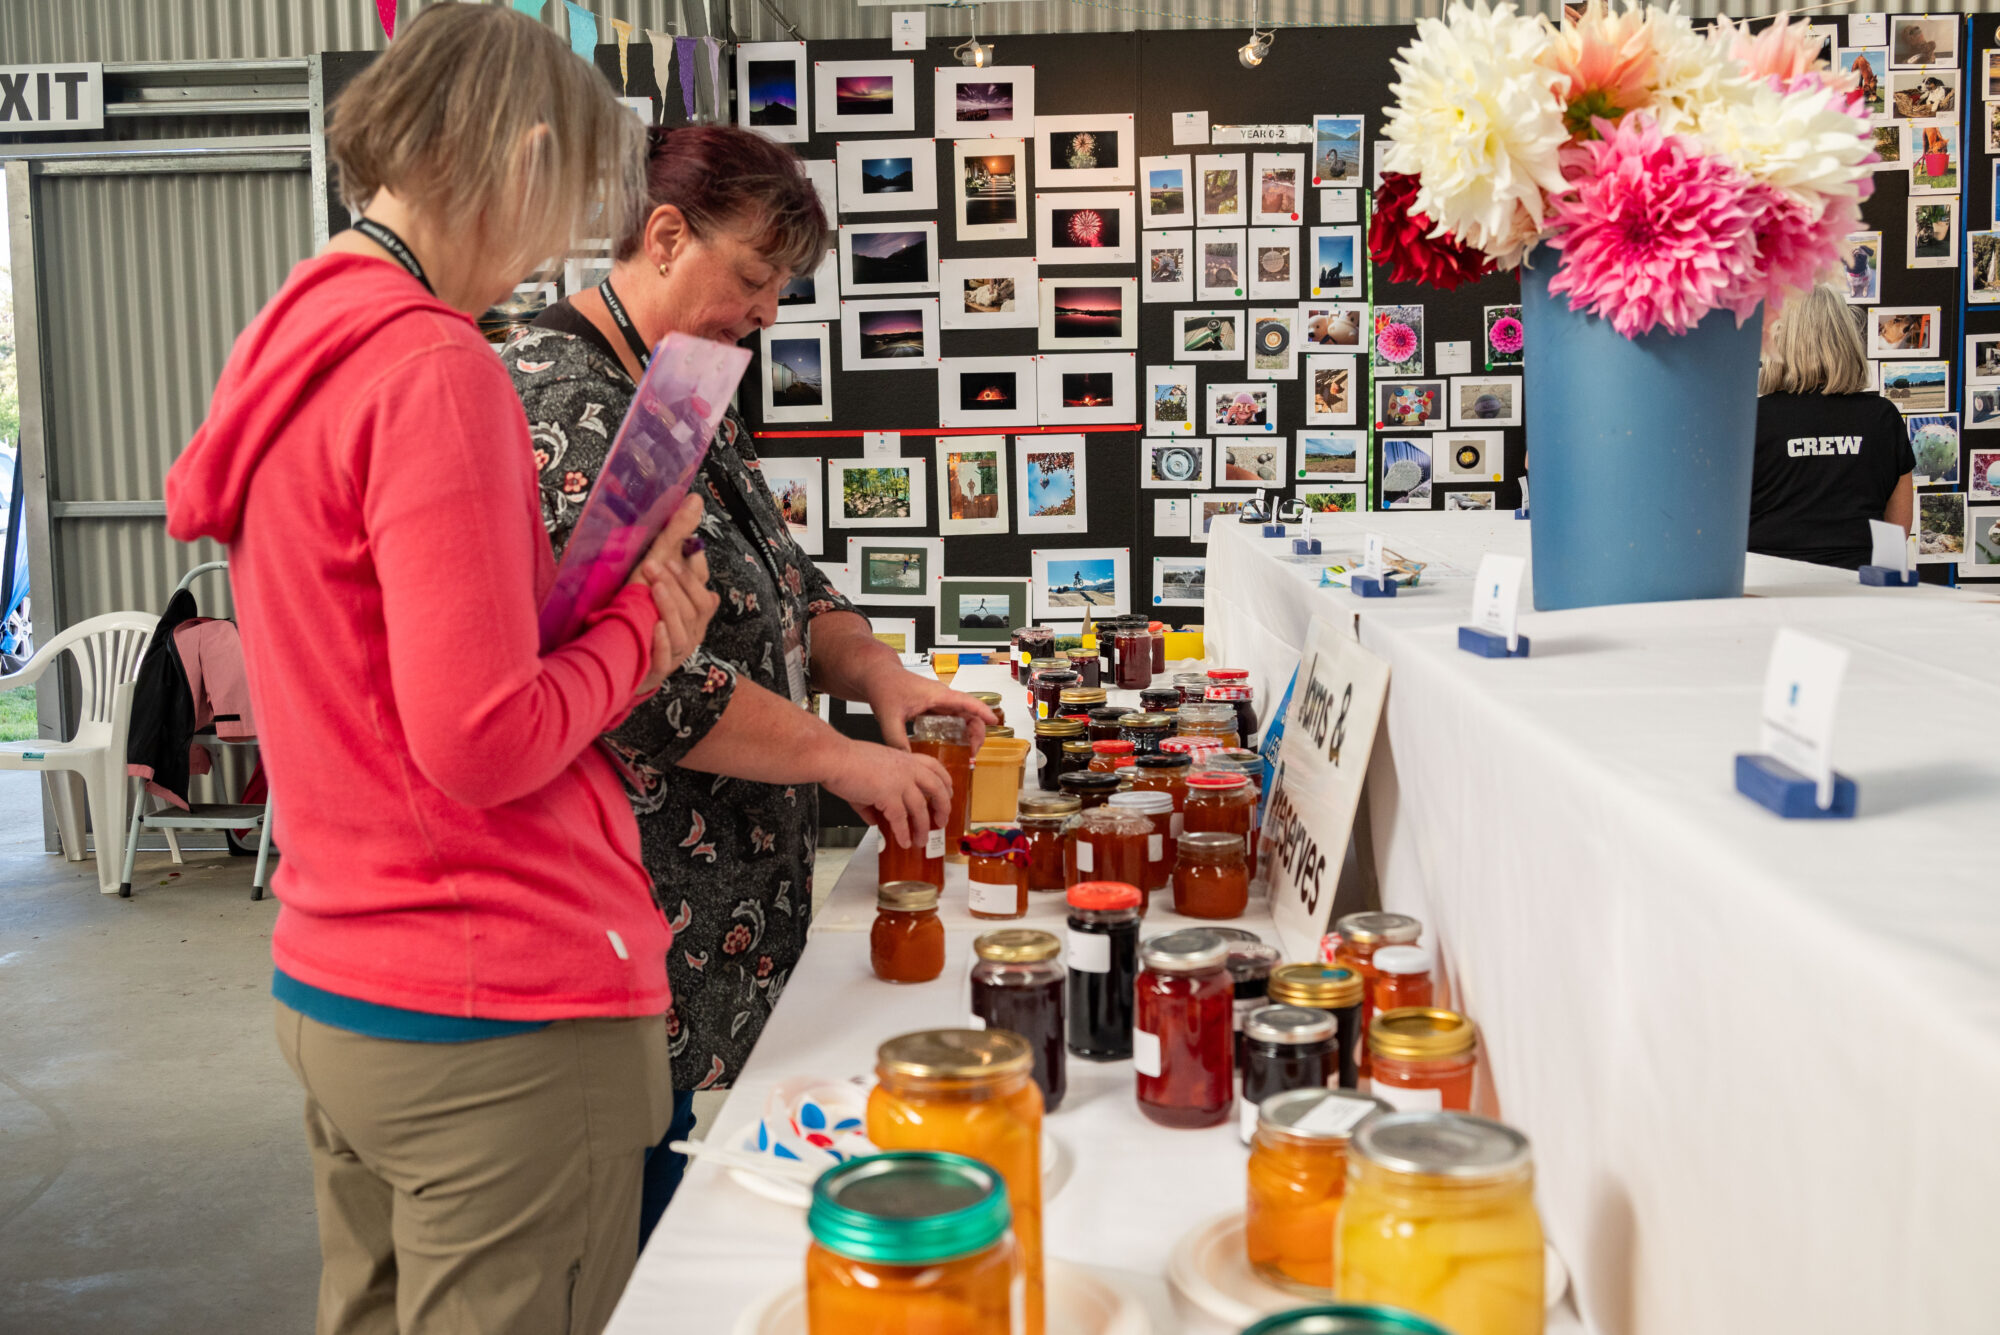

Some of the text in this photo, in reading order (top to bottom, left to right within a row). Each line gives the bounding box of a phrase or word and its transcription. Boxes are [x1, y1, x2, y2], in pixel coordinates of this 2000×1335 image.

[1240, 129, 1285, 139] YEAR 0-2
[1787, 436, 1863, 457] CREW
[1298, 652, 1352, 768] Jams &
[1269, 759, 1326, 916] Preserves
